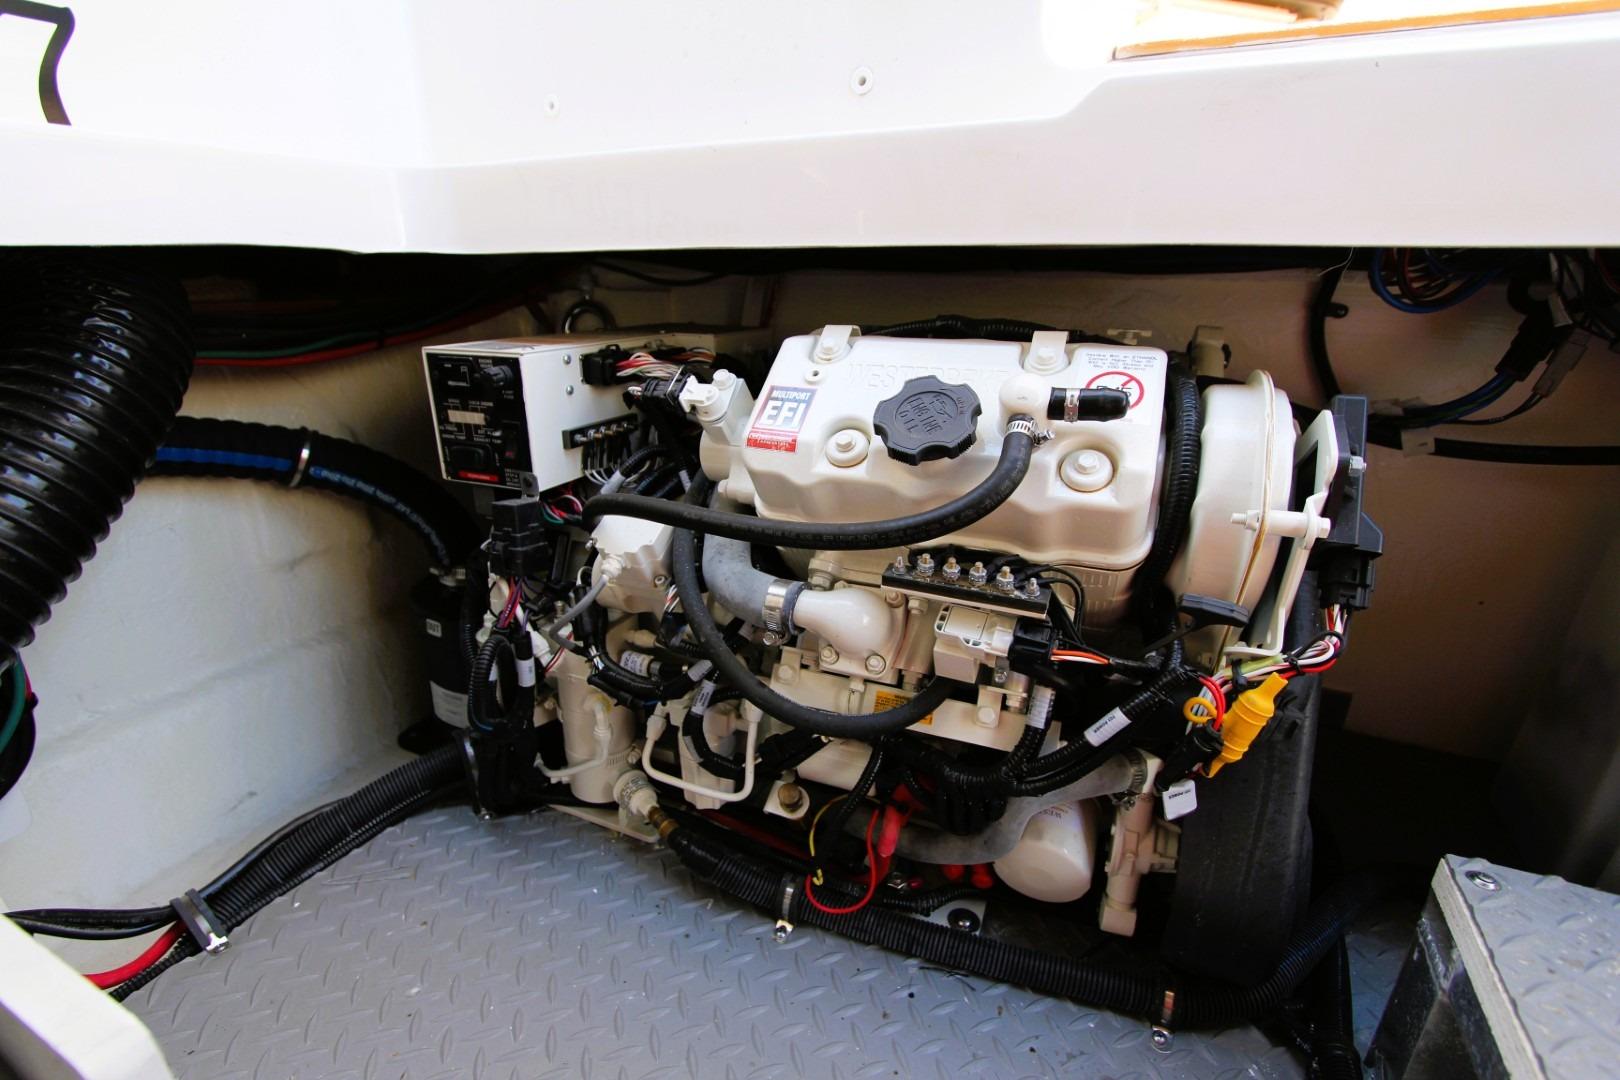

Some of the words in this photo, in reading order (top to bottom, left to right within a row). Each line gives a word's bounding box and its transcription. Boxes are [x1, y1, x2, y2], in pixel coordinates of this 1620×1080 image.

[771, 390, 812, 401] MULTIPORT
[759, 399, 807, 429] EFI
[898, 409, 920, 433] OIL
[907, 396, 942, 434] ENGINE
